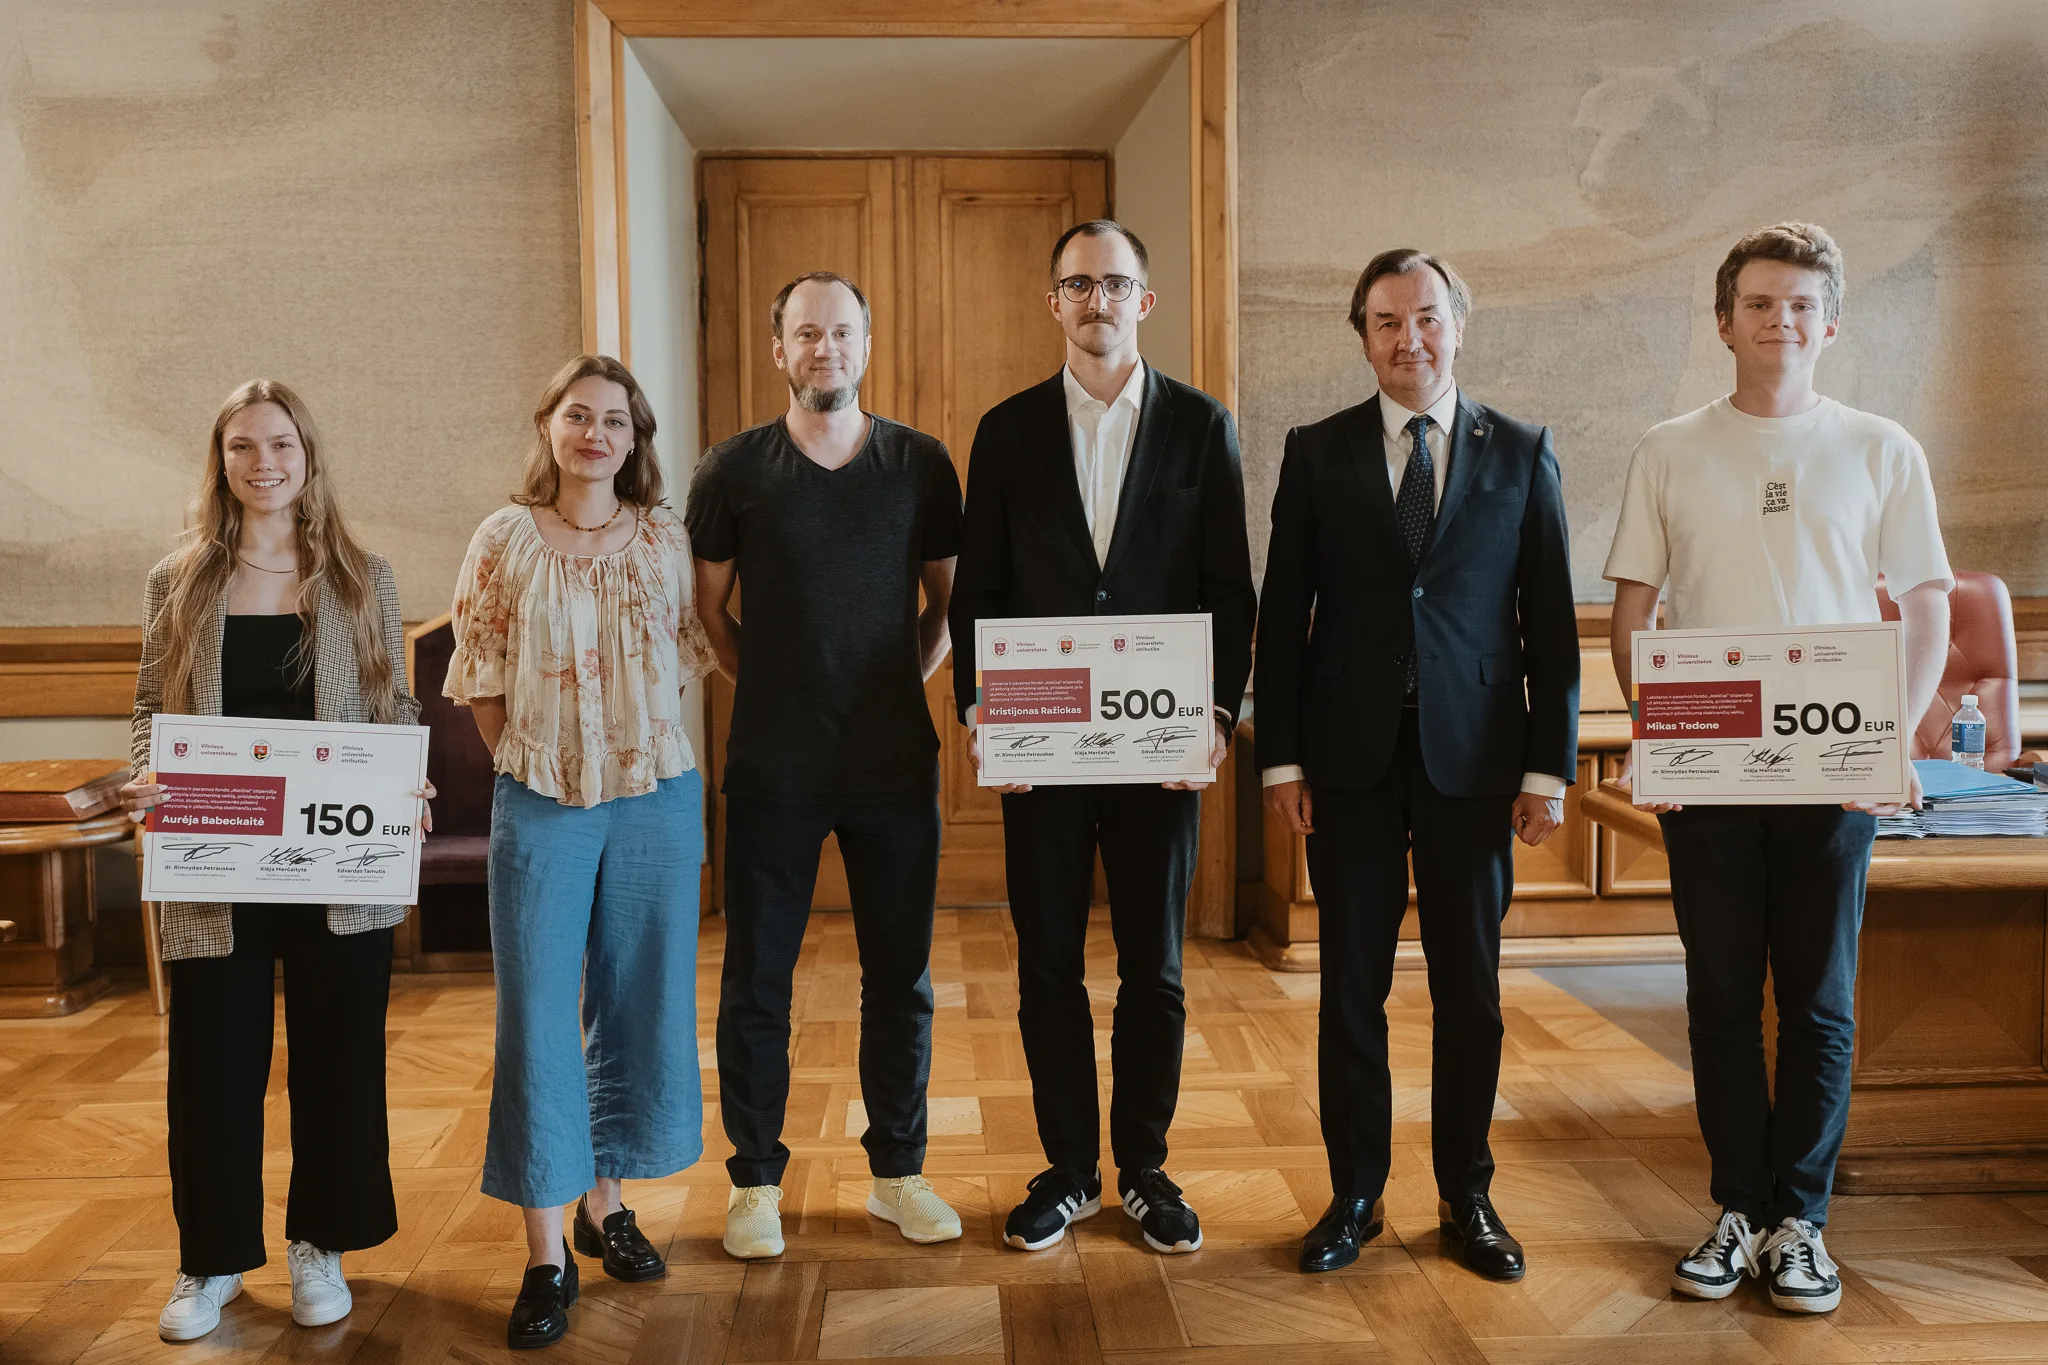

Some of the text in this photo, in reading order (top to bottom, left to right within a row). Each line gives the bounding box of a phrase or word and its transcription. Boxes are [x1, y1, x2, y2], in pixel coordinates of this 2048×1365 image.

[1765, 490, 1773, 498] la
[1766, 499, 1776, 507] ça
[1762, 504, 1790, 515] passer
[1100, 689, 1204, 720] 500 EUR
[990, 706, 1082, 717] Kristijonas Ražickas
[1773, 702, 1894, 736] 500 EUR
[1646, 722, 1720, 730] Mikas Tedone
[162, 815, 264, 826] Aurėja Babeckaitė
[300, 803, 410, 837] 150 EUR
